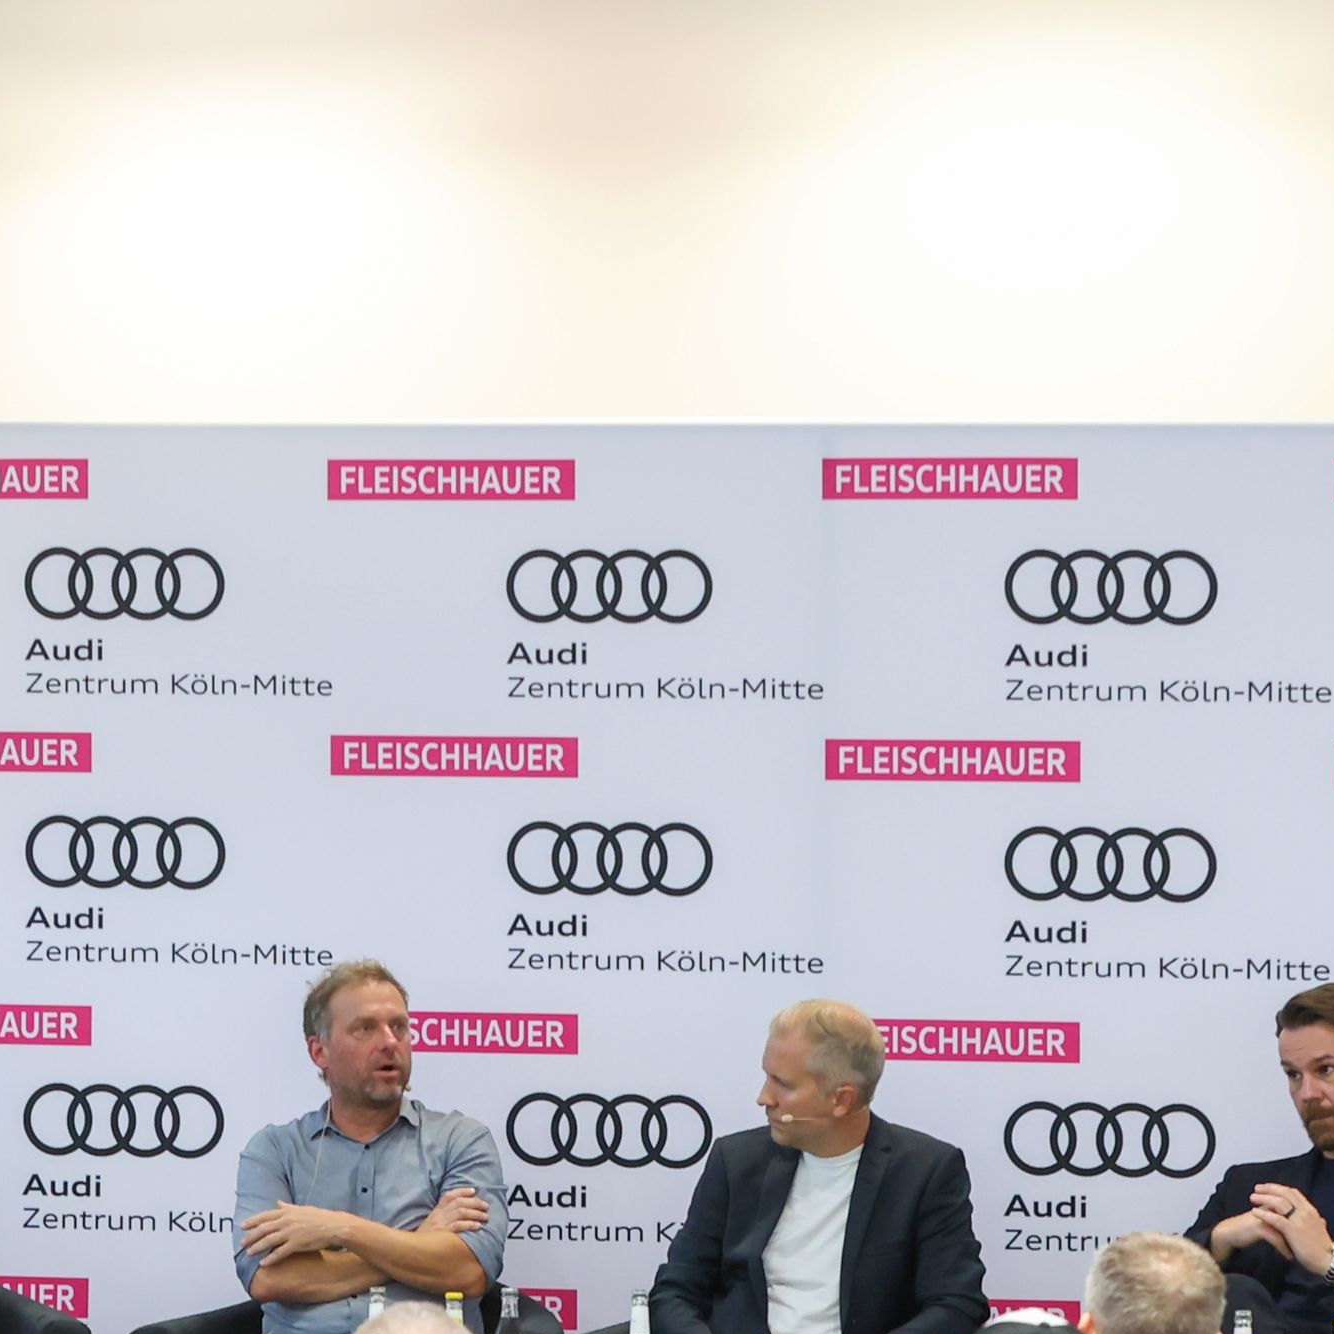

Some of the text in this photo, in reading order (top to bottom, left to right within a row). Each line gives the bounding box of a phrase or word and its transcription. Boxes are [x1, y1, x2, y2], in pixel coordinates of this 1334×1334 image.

[340, 465, 562, 495] FLEISCHHAUER
[835, 464, 1065, 495] FLEISCHHAUER
[25, 638, 103, 661] Audi
[507, 642, 587, 665] Audi
[1004, 644, 1088, 668] Audi
[26, 672, 333, 697] Zentrum Köln-Mitte
[508, 677, 824, 701] Zentrum Köln-Mitte
[1005, 679, 1332, 704] Zentrum Köln-Mitte
[343, 742, 565, 772] FLEISCHHAUER
[839, 746, 1067, 776] FLEISCHHAUER
[25, 906, 104, 930] Audi
[507, 913, 588, 937] Audi
[1004, 919, 1087, 944] Audi
[26, 940, 333, 966] Zentrum Köln-Mitte
[508, 948, 824, 974] Zentrum Köln-Mitte
[1005, 954, 1331, 981] Zentrum Köln-Mitte
[22, 1173, 101, 1198] Audi
[507, 1184, 587, 1208] Audi
[1003, 1193, 1087, 1219] Audi
[22, 1207, 157, 1232] Zentrum
[507, 1218, 644, 1243] Zentrum
